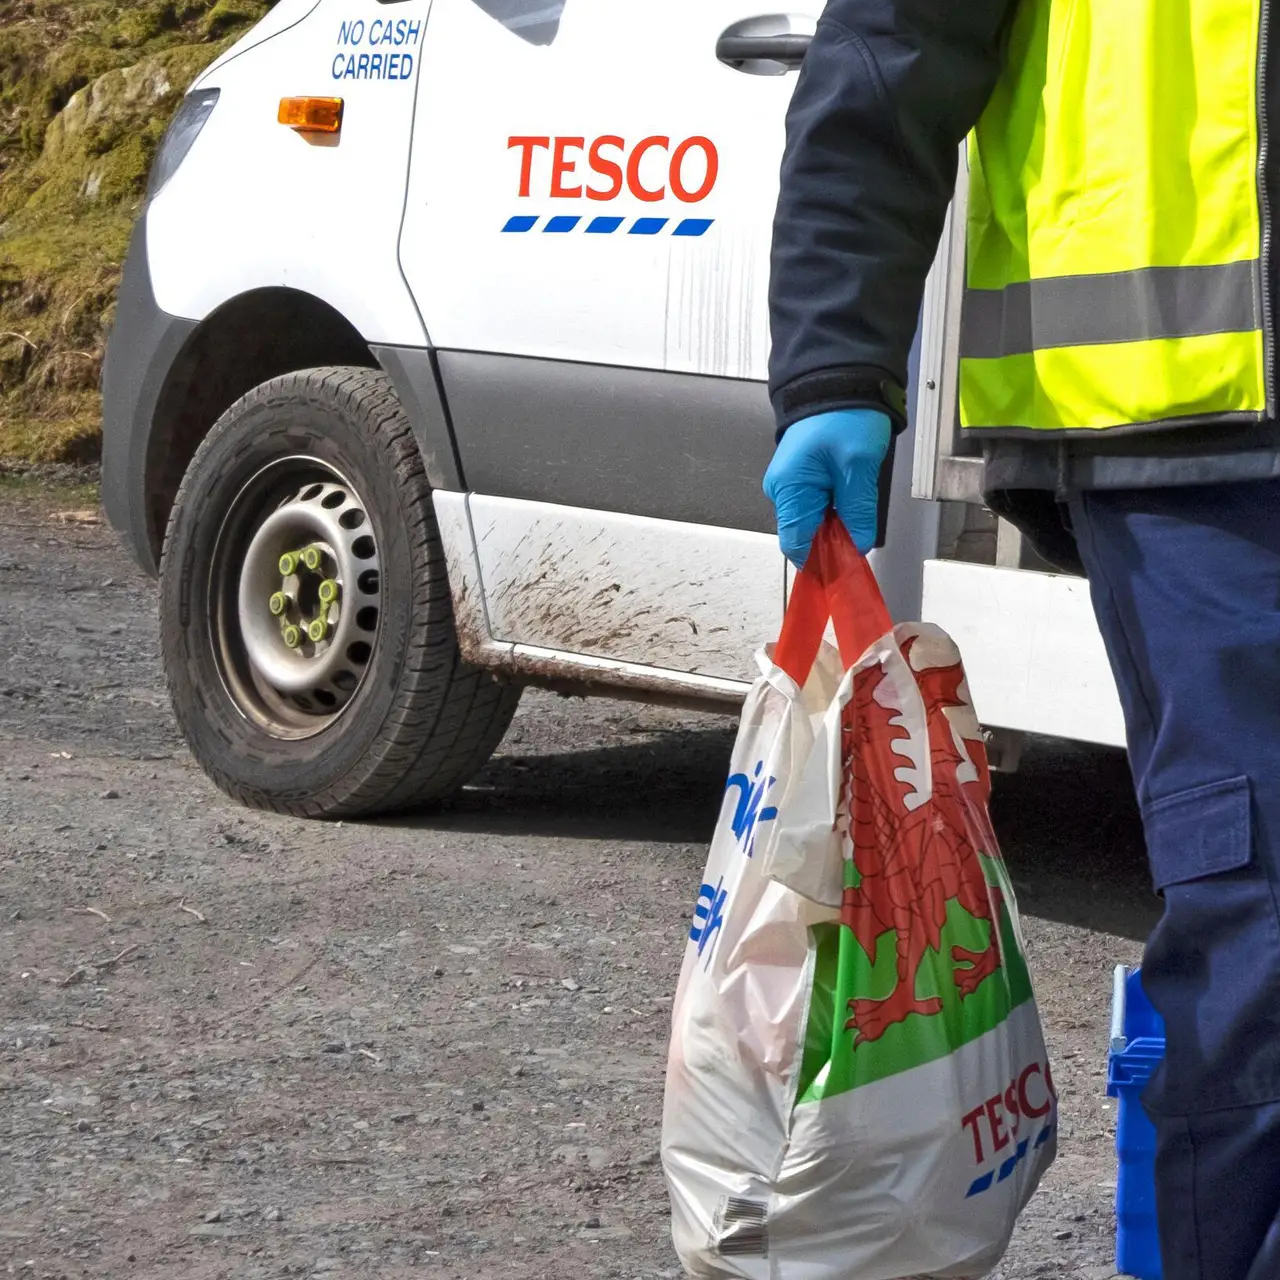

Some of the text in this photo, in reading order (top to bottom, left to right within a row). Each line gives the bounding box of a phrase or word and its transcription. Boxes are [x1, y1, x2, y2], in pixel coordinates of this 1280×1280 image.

[337, 19, 421, 46] NO CASH
[332, 53, 414, 81] CARRIED
[507, 134, 719, 203] TESCO
